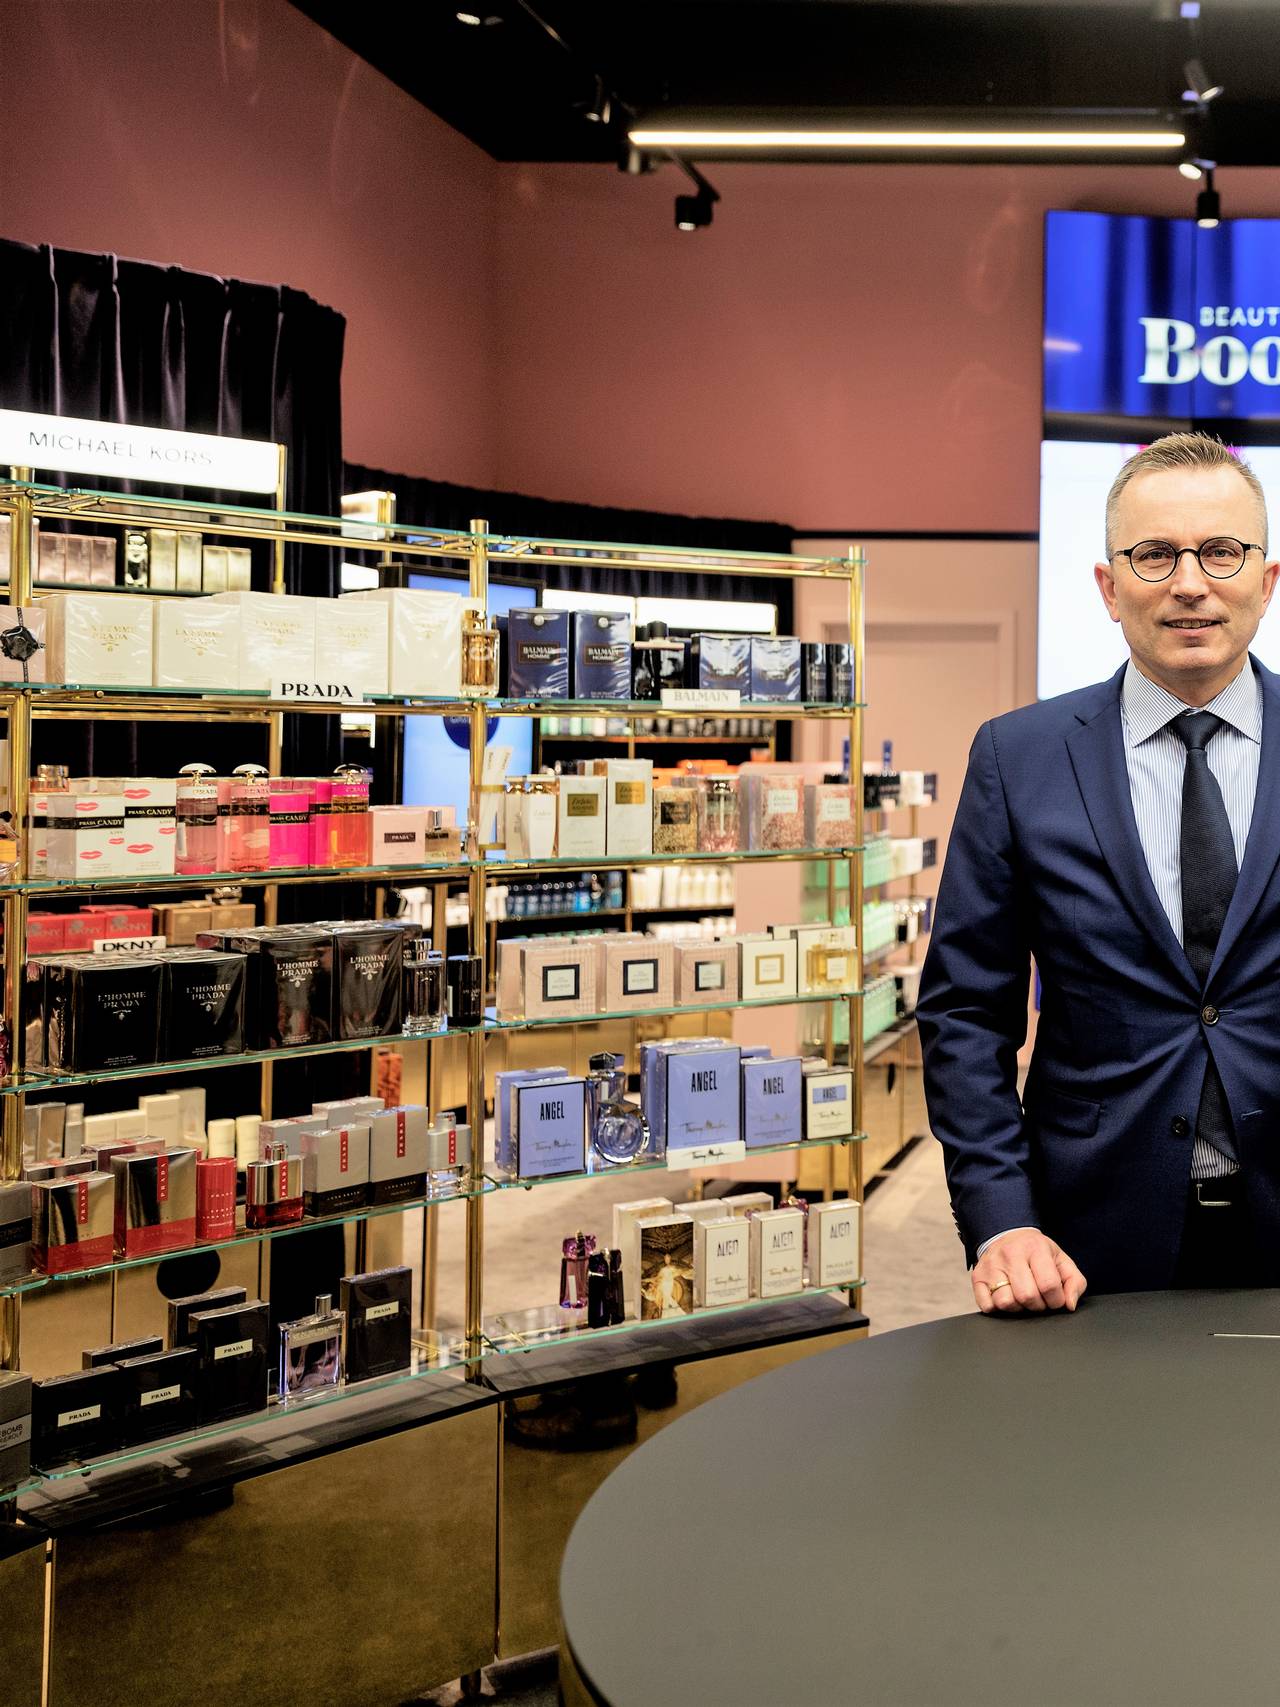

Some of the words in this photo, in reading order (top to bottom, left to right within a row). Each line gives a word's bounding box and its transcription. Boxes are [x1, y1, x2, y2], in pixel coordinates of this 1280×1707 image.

[29, 431, 136, 458] MICHAEL
[150, 446, 212, 465] KORS
[281, 682, 354, 698] PRADA
[674, 691, 729, 701] BALMAIN
[146, 808, 173, 816] CANDY
[97, 818, 123, 826] CANDY
[102, 941, 157, 952] DKNY
[277, 960, 319, 971] L'HOMME
[355, 962, 385, 971] PRADA
[282, 968, 313, 977] PRADA
[186, 983, 231, 994] L'HOMME
[192, 991, 226, 1001] PRADA
[104, 999, 141, 1009] PRADA
[691, 1070, 718, 1093] ANGEL
[763, 1076, 785, 1095] ANGEL
[540, 1101, 565, 1121] ANGEL
[223, 1344, 244, 1354] PRADA
[151, 1390, 172, 1400] PRADA
[68, 1411, 91, 1421] PRADA
